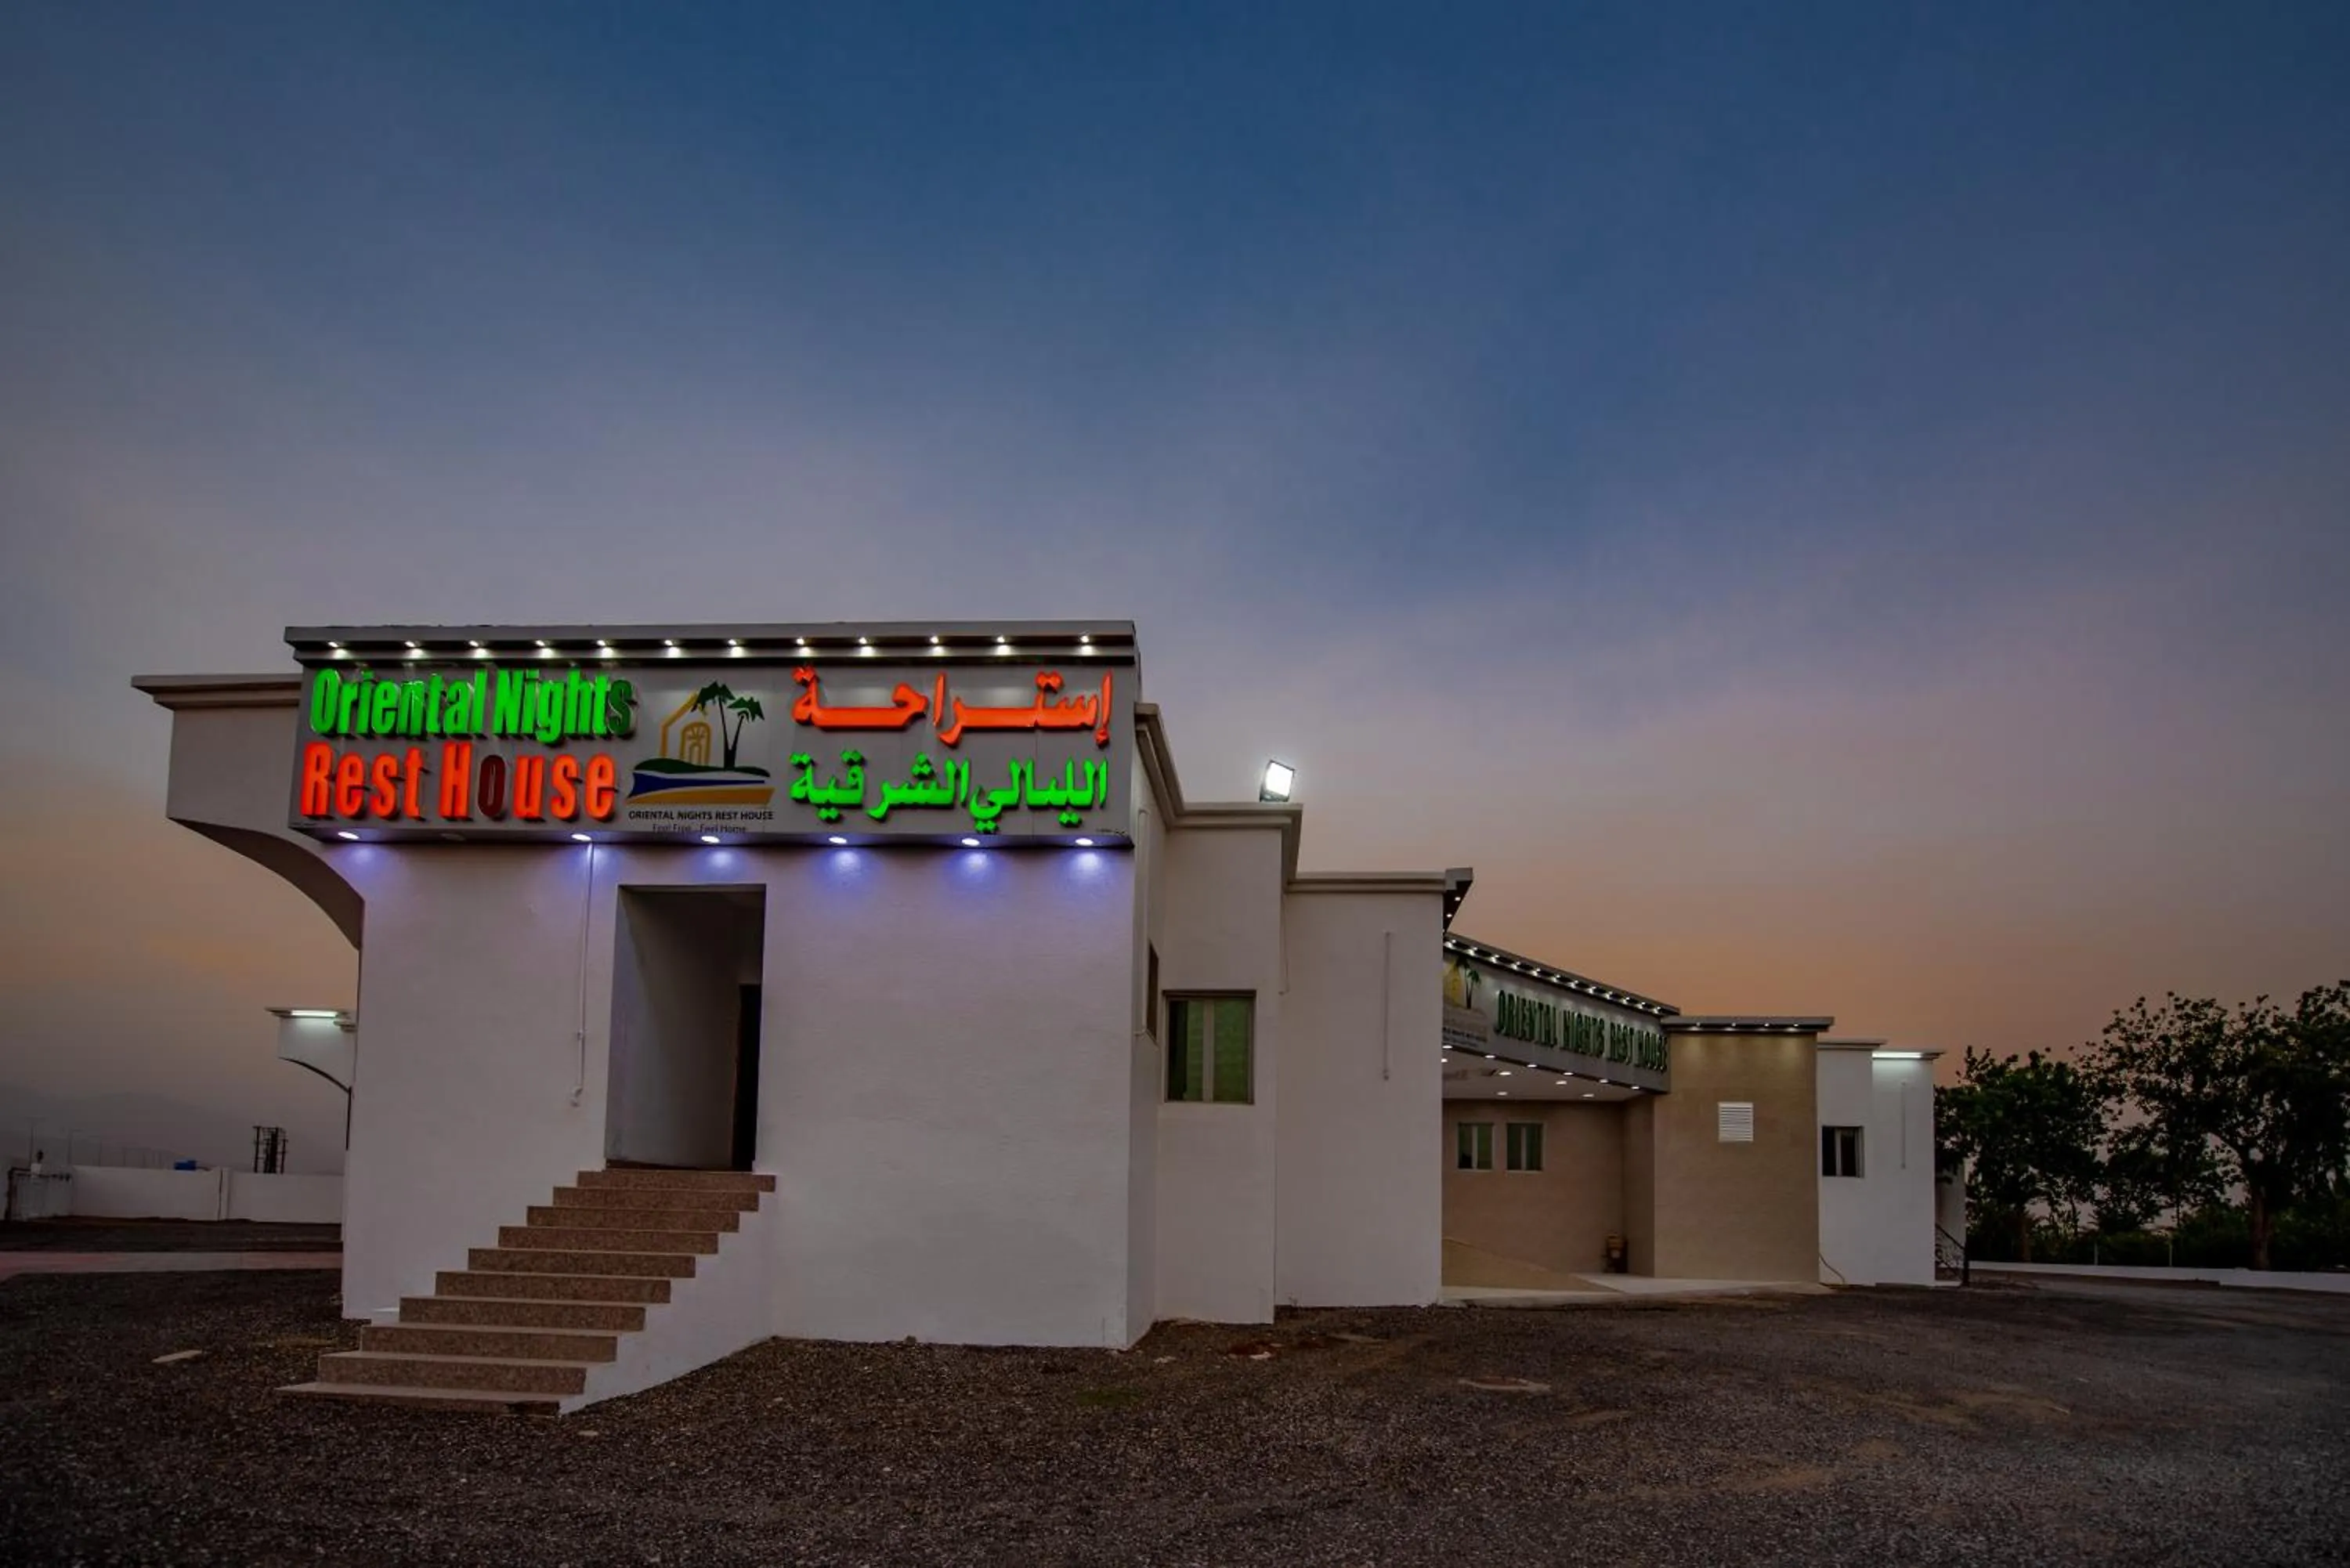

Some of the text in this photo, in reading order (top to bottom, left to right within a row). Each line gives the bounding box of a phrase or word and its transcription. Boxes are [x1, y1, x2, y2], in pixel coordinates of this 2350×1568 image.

[310, 668, 636, 743] Oriental Nights
[791, 663, 1113, 747] إستراحة
[301, 740, 616, 820] Rest House
[628, 810, 774, 821] ORIENTAL NIGHTS REST HOUSE
[790, 751, 1108, 833] الليالي الشرقية
[1497, 989, 1557, 1047] ORIENTAL
[1562, 1009, 1605, 1057] NIGHTS
[1609, 1021, 1635, 1064] REST
